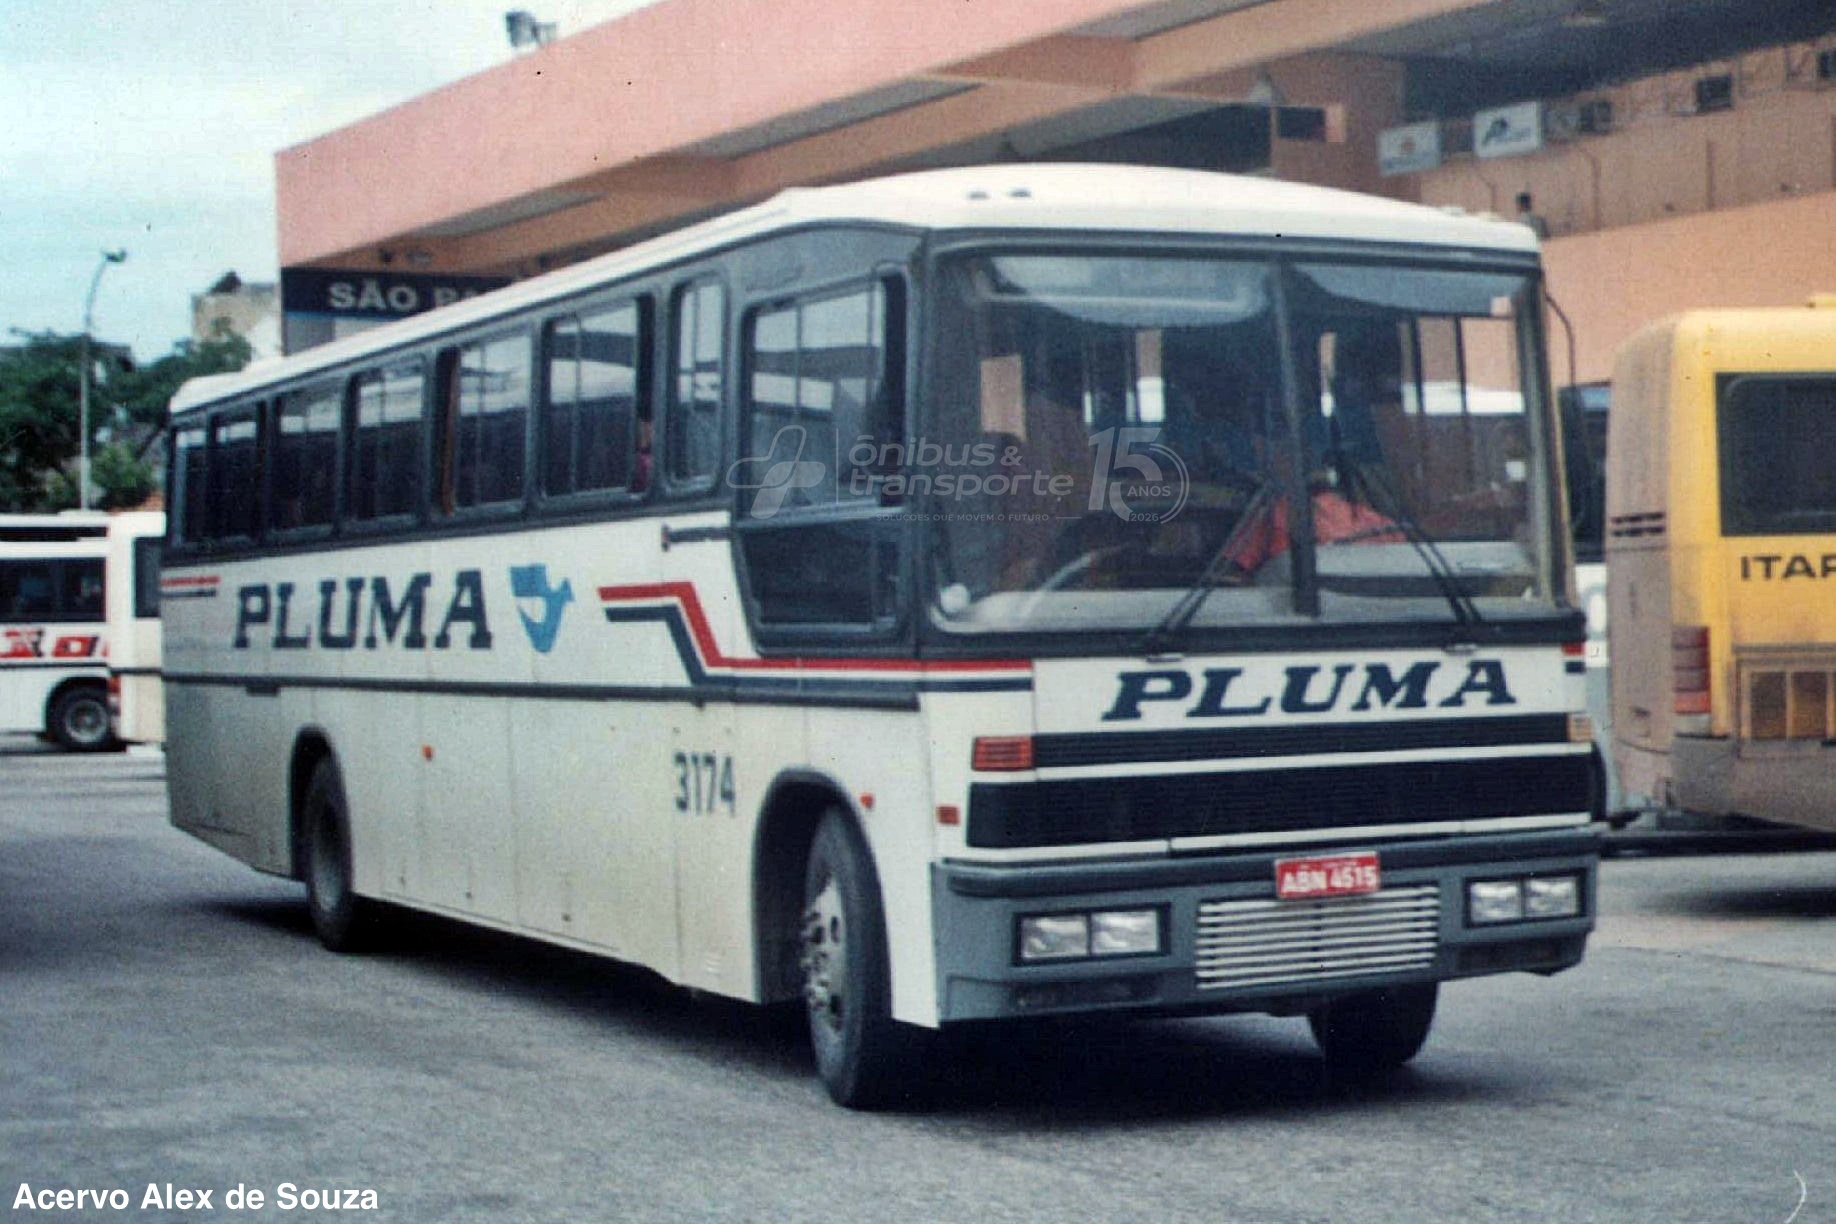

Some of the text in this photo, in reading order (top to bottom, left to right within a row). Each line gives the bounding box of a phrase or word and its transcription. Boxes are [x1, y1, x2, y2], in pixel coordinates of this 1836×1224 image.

[331, 278, 417, 311] SÃO
[234, 568, 492, 649] PLUMA
[1101, 659, 1517, 721] PLUMA
[674, 751, 736, 818] 3174
